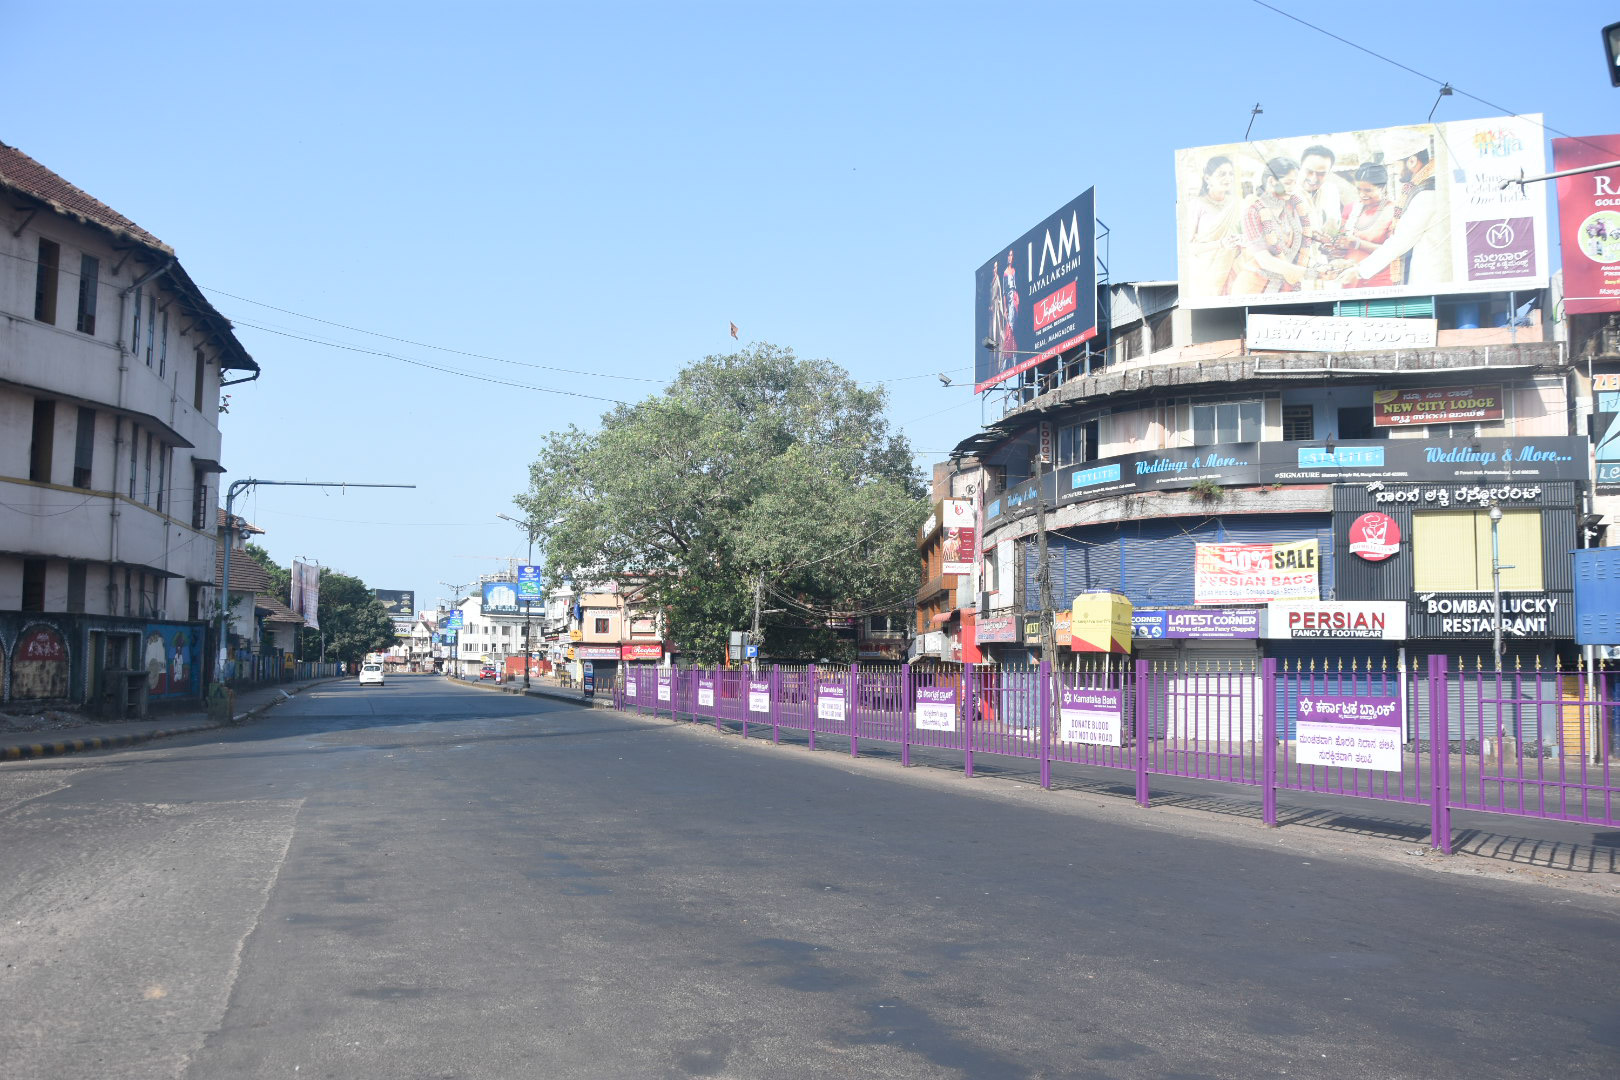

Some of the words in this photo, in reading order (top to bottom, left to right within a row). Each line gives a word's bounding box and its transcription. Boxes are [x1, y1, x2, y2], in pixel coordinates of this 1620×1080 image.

[1028, 255, 1081, 296] JAYALAKSHMI
[1383, 402, 1414, 414] NEW
[1416, 400, 1448, 412] CITY
[1449, 397, 1496, 410] LODGE
[1424, 446, 1498, 466] Weddings
[1501, 448, 1513, 462] &
[1135, 458, 1188, 475] Weddings
[1191, 457, 1201, 469] &
[1375, 488, 1420, 502] ಬಾಂಬೆ
[1274, 548, 1315, 570] SALE
[1271, 574, 1314, 587] BAGS
[1427, 599, 1496, 614] BOMBAY
[1502, 598, 1558, 613] LUCKY
[1168, 614, 1213, 626] LATEST
[1213, 615, 1256, 625] CORNER
[1289, 611, 1385, 629] PERSIAN
[1292, 629, 1321, 638] FANCY
[1322, 630, 1331, 638] &
[1331, 629, 1382, 638] FOOTWEAR
[747, 646, 756, 657] P
[1073, 693, 1102, 704] Karnataka
[1102, 695, 1117, 705] Bank
[1071, 719, 1091, 729] DONATE
[1092, 720, 1109, 731] BLOOD
[1068, 730, 1078, 739] BUT
[1078, 731, 1089, 740] NOT
[1089, 731, 1098, 741] ON
[1098, 732, 1113, 743] ROAD
